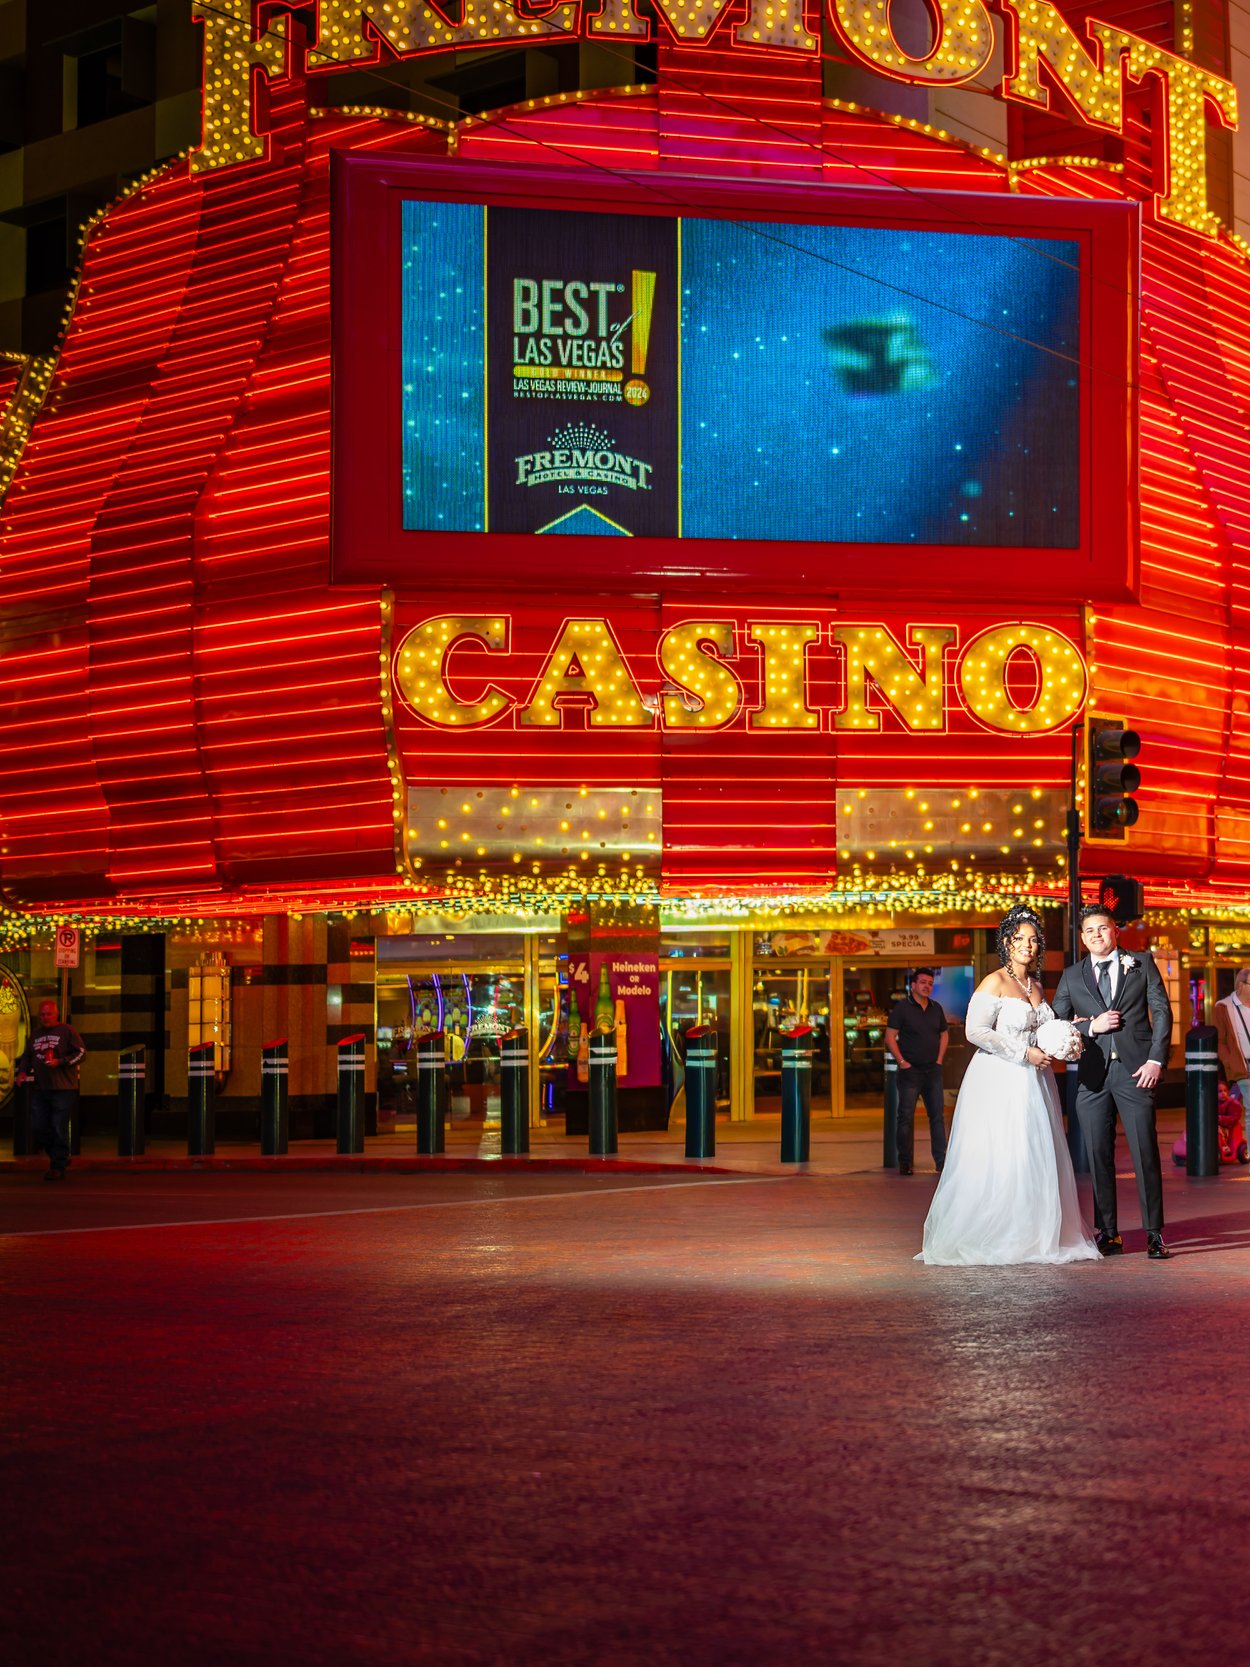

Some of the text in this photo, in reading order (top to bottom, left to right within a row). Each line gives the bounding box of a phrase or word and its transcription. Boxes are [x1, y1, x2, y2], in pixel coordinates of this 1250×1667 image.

[513, 337, 624, 368] LAS VEGAS
[513, 378, 622, 394] LAS VEGAS REVIEW-JOURNAL
[626, 386, 647, 399] 2024
[514, 449, 653, 490] FREMONT
[534, 470, 569, 482] HOTEL
[588, 470, 629, 484] CASINO
[558, 485, 608, 495] LAS VEGAS
[393, 614, 1087, 737] CASINO
[568, 962, 590, 984] $4
[612, 961, 656, 973] Heineken
[629, 975, 640, 983] OR
[617, 985, 652, 996] Modelo
